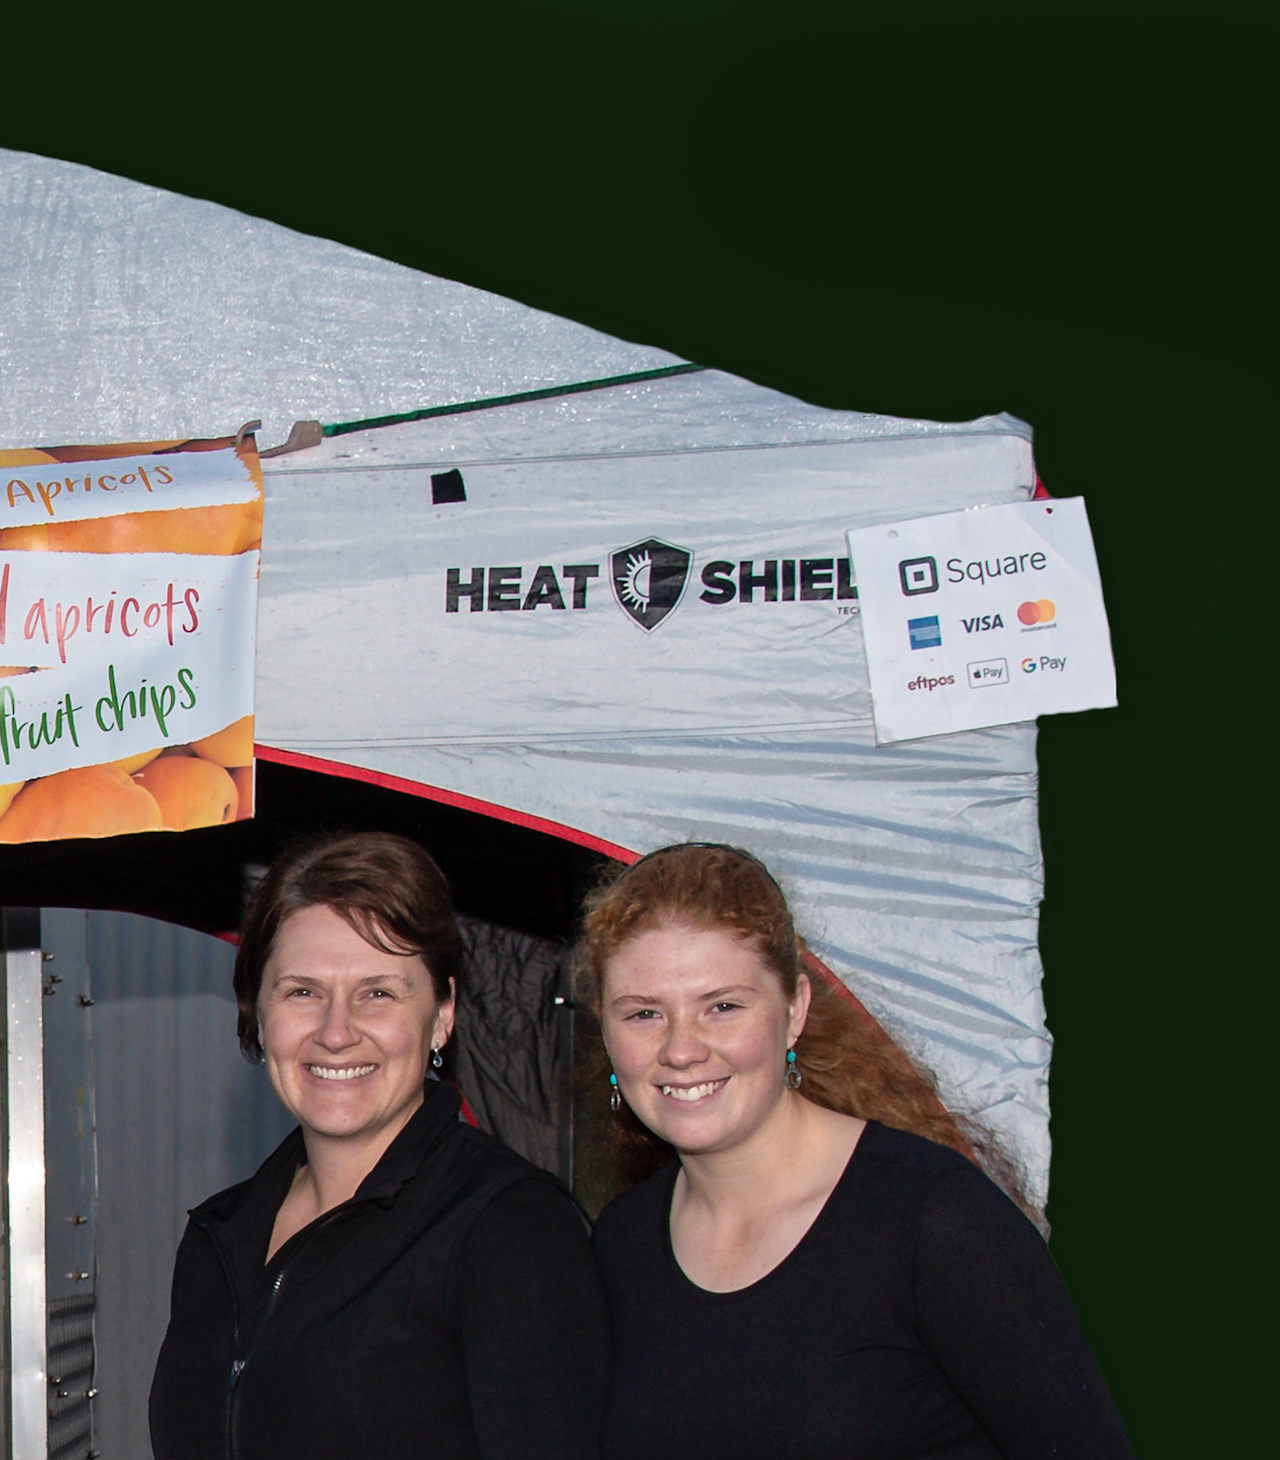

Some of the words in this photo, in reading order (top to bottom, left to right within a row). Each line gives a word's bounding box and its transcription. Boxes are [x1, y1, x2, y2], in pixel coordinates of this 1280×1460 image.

[6, 463, 175, 516] Apricots
[946, 552, 1047, 585] Square
[445, 564, 600, 613] HEAT
[23, 582, 200, 663] apricots
[837, 606, 860, 616] TEC
[960, 614, 1005, 634] VISA
[982, 667, 1002, 681] Pay
[1040, 656, 1067, 671] Pay
[907, 674, 955, 691] eftpos
[94, 665, 197, 738] chips
